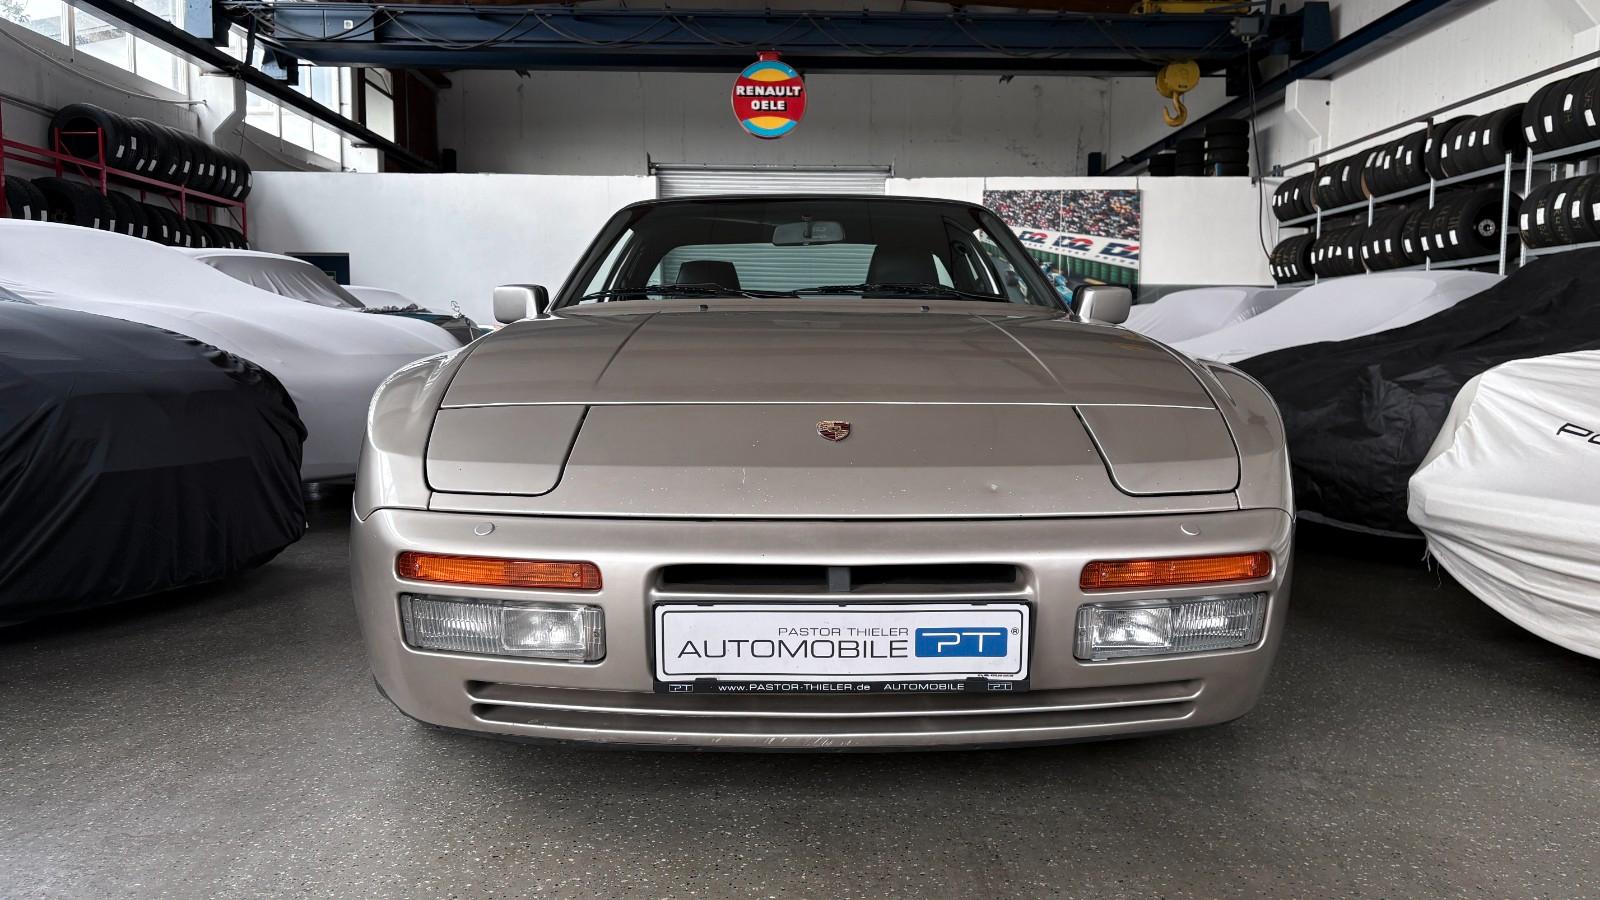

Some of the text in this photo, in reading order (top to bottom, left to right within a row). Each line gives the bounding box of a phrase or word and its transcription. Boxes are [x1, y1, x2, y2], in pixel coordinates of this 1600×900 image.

[736, 85, 801, 96] RENAULT
[751, 100, 785, 110] OELE
[778, 627, 909, 637] PASTOR THIELER
[677, 632, 1001, 658] AUTOMOBILE PT
[717, 682, 871, 692] www.PASTOR-THIELER.de
[883, 683, 965, 691] AUTOMOBILE
